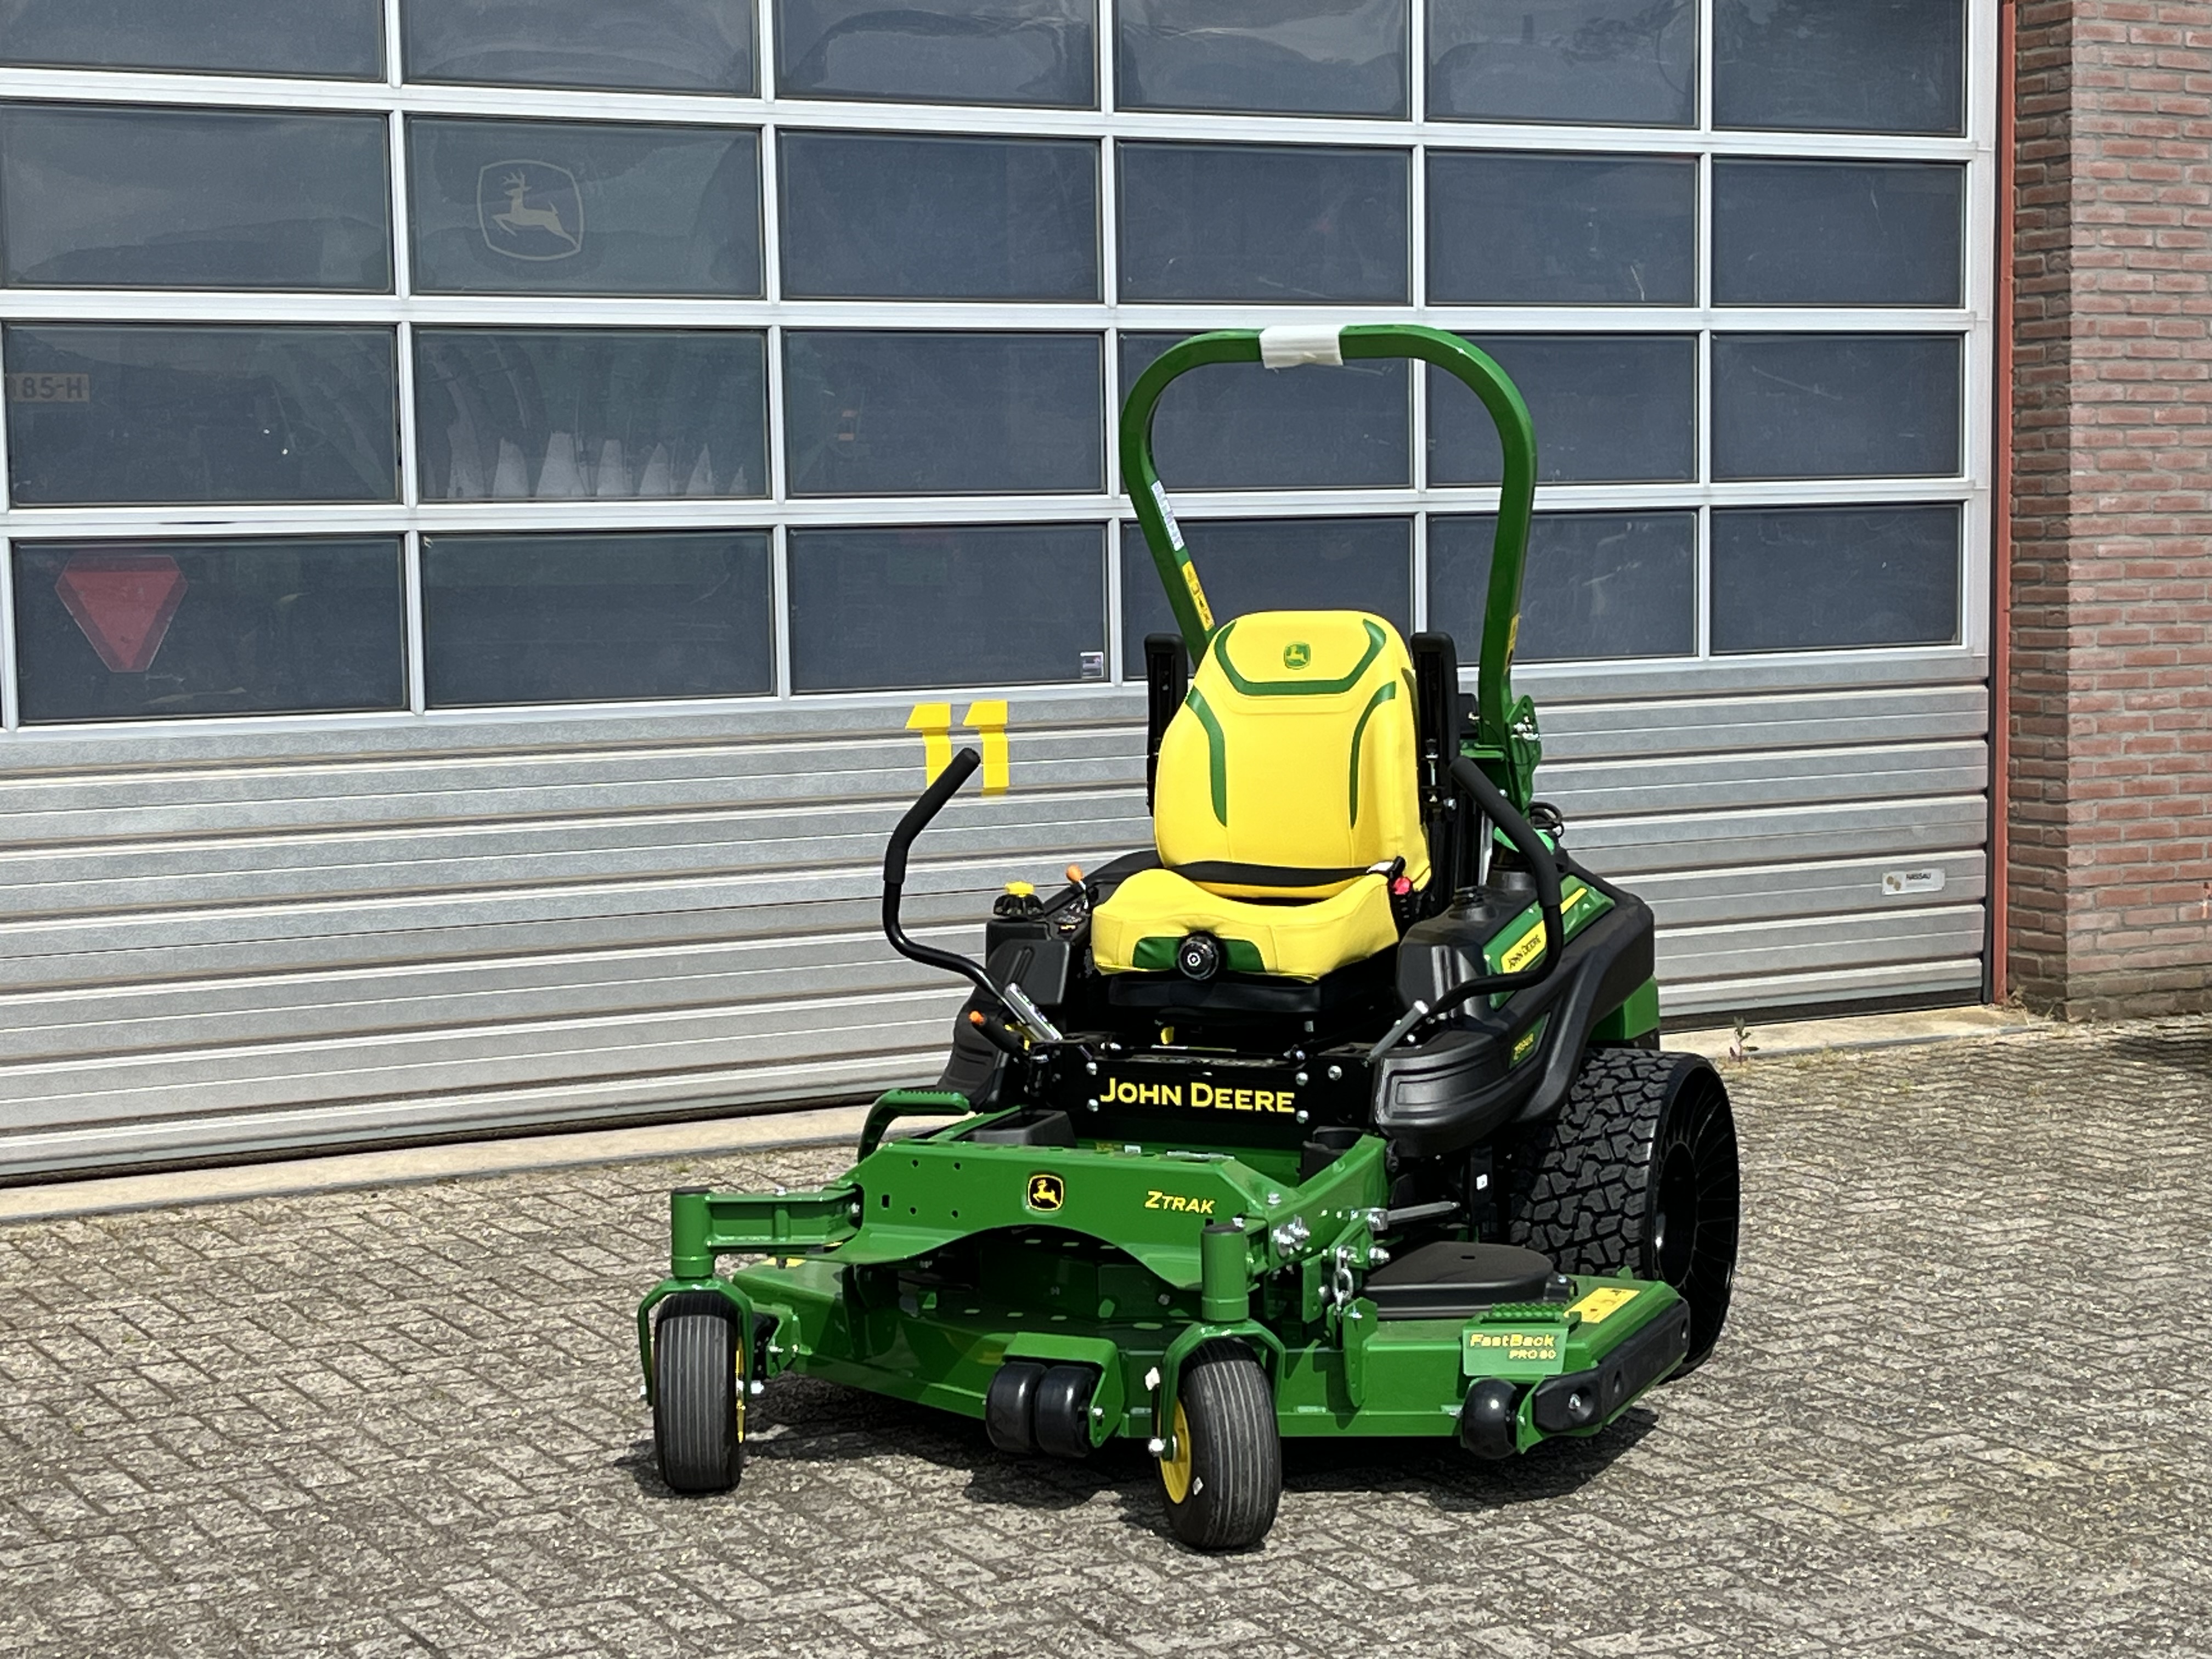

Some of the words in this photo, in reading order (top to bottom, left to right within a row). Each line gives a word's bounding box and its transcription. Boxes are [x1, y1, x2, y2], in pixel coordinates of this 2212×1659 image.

[906, 699, 1009, 797] 11
[1099, 1077, 1182, 1106] JOHN
[1190, 1082, 1296, 1114] DEERE
[1144, 1190, 1216, 1214] ZTRAK
[1470, 1333, 1555, 1348] FastBack
[1509, 1348, 1538, 1360] PRO
